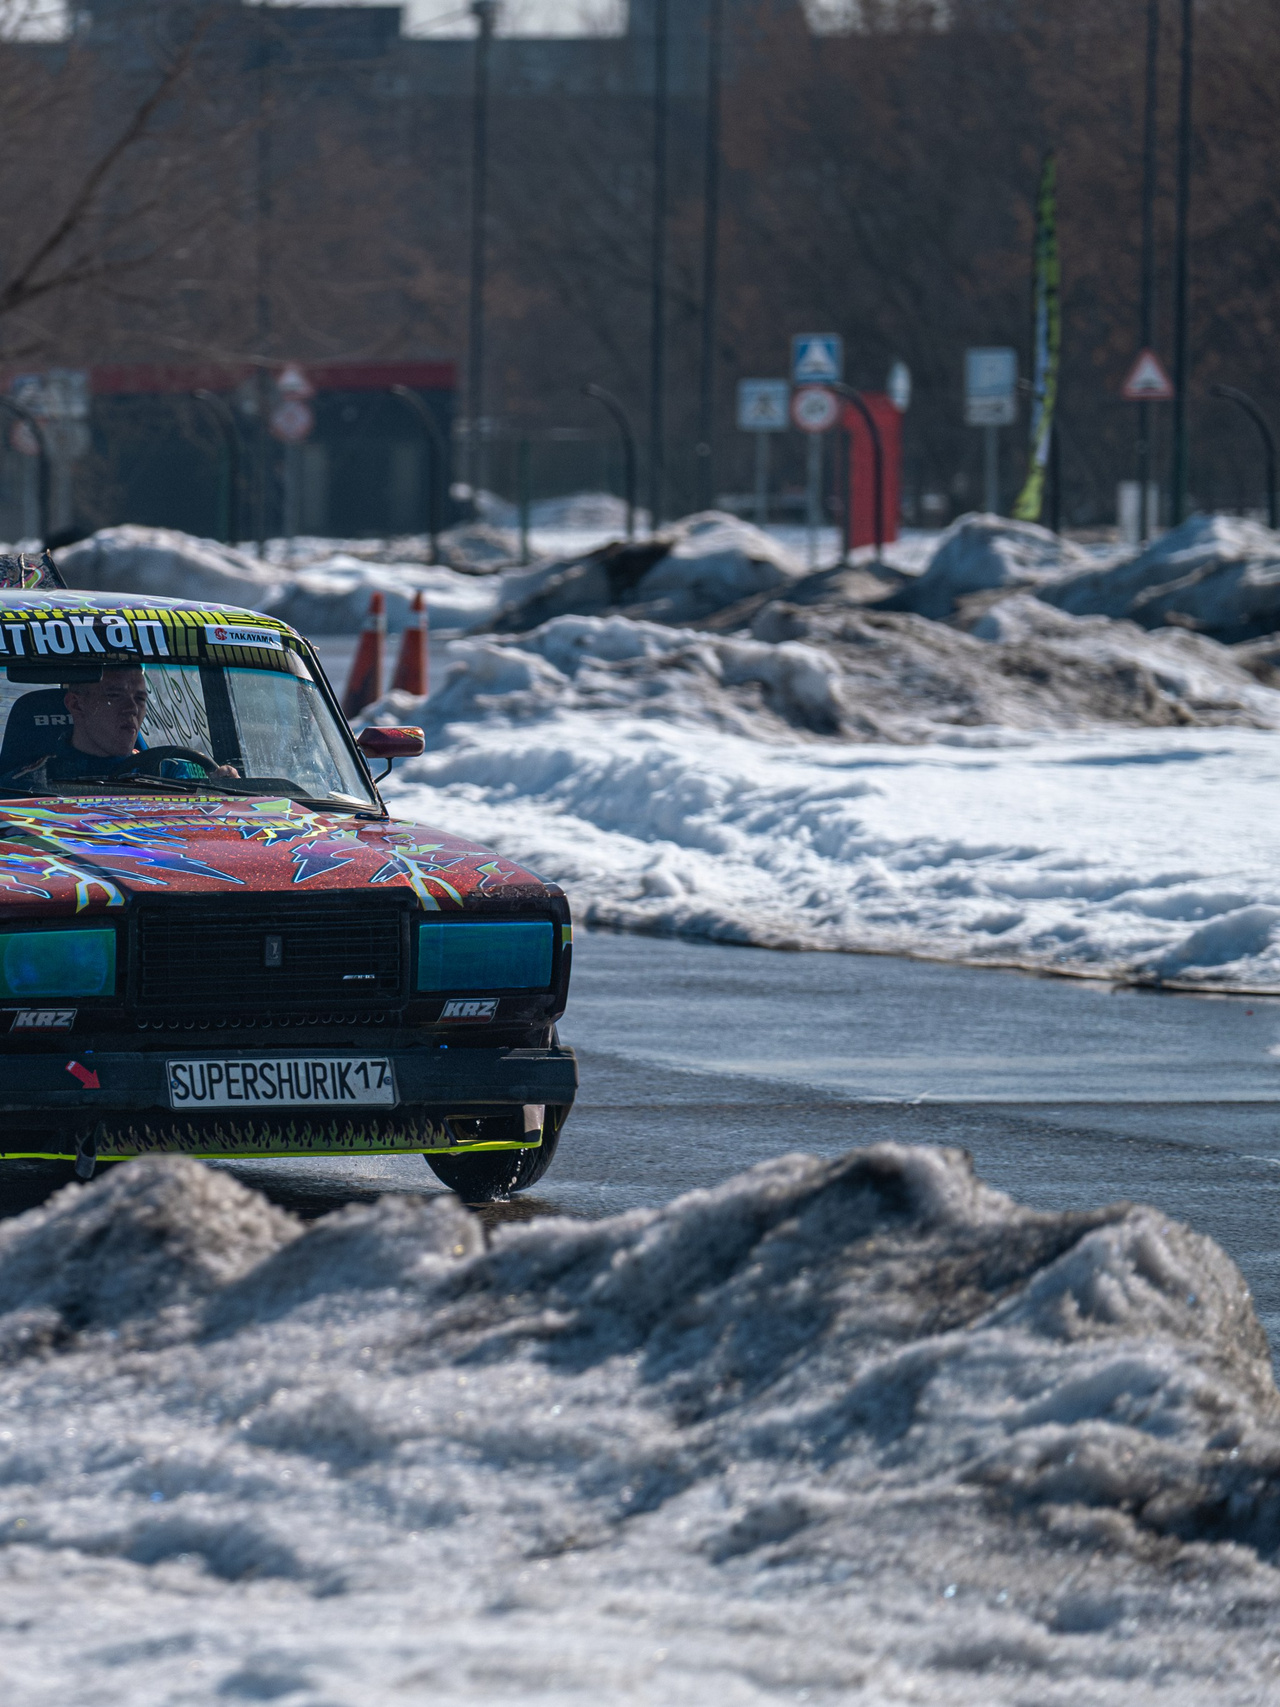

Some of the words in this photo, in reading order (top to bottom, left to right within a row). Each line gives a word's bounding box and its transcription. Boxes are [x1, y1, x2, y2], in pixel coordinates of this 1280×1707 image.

[229, 632, 275, 644] TAKAYAMA
[33, 714, 74, 726] BRI
[443, 1001, 496, 1016] KRZ
[15, 1011, 74, 1026] KRZ
